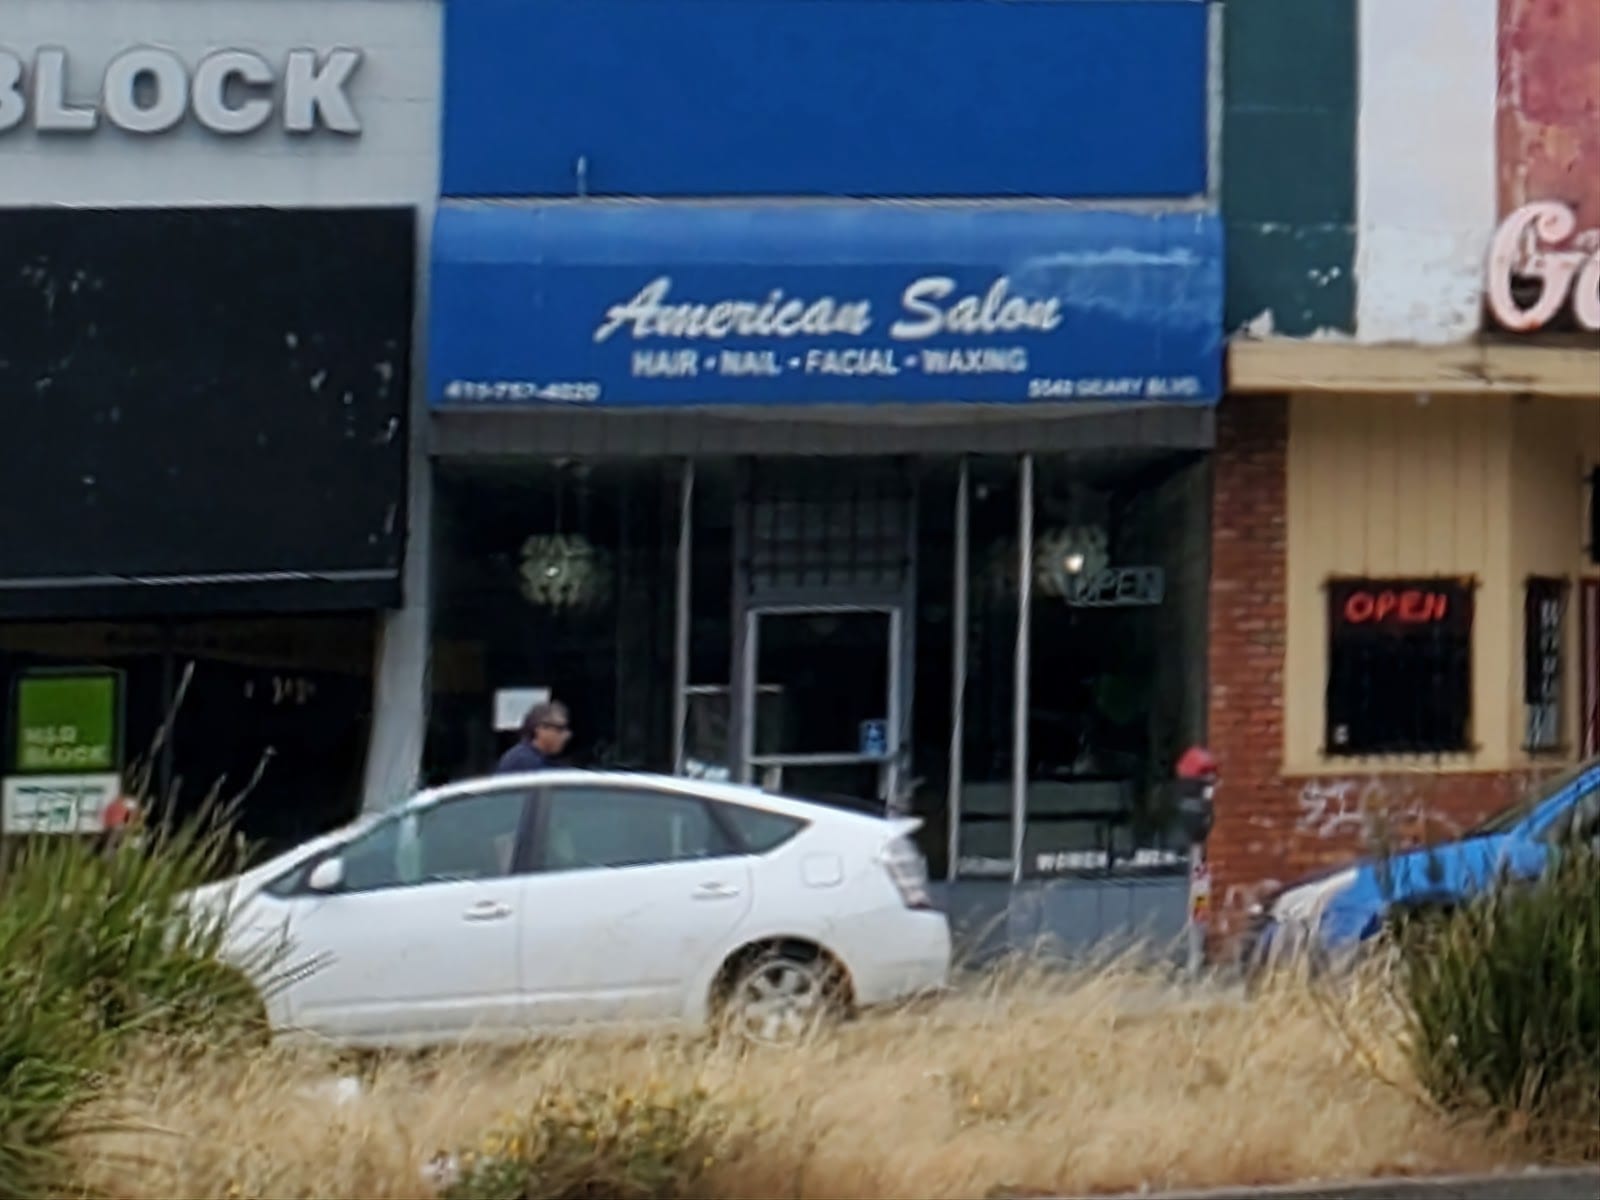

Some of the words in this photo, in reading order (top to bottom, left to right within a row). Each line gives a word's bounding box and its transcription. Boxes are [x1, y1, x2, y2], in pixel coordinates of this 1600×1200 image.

[593, 275, 871, 342] American
[889, 275, 1063, 340] Salon
[632, 349, 698, 377] HAIR
[719, 349, 782, 376] NAIL
[805, 348, 898, 376] FACIAL
[921, 346, 1028, 374] WAXING
[1344, 591, 1447, 623] OPEN
